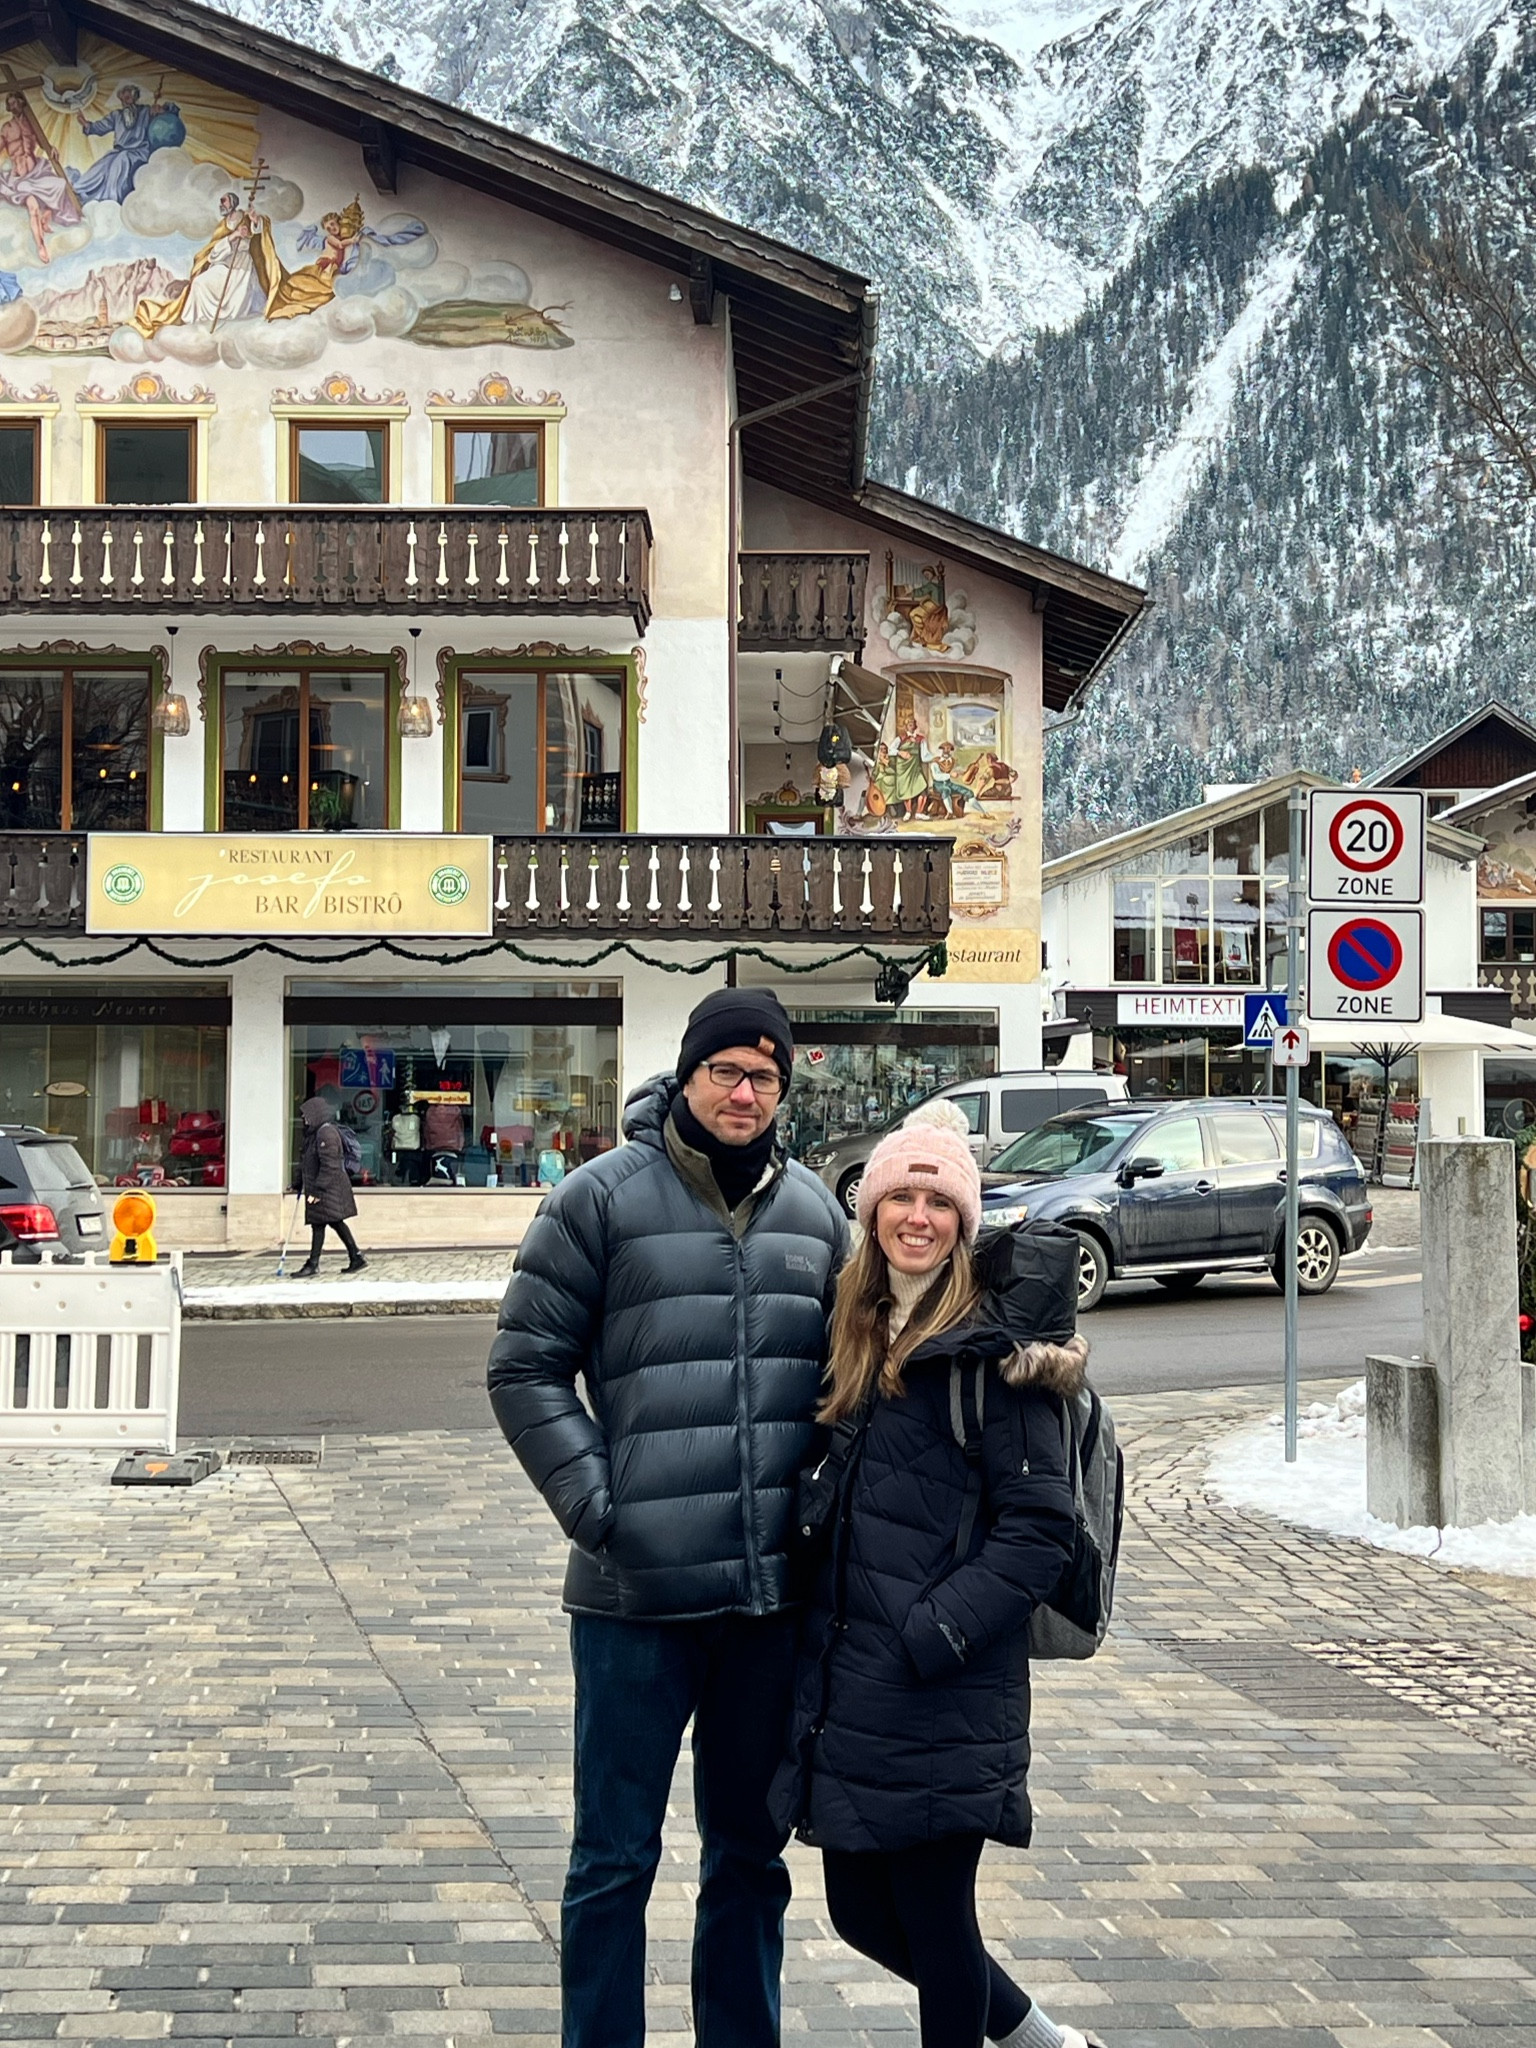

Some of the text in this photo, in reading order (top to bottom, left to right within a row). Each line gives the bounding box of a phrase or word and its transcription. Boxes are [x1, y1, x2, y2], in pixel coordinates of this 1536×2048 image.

[1346, 819, 1388, 853] 20
[228, 849, 333, 864] RESTAURANT
[173, 849, 372, 919] josefs
[1337, 877, 1394, 895] ZONE
[255, 891, 403, 915] BAR BISTRÔ
[92, 1001, 167, 1017] Neuner
[1135, 997, 1241, 1015] HEIMTEXTI
[1336, 996, 1393, 1014] ZONE
